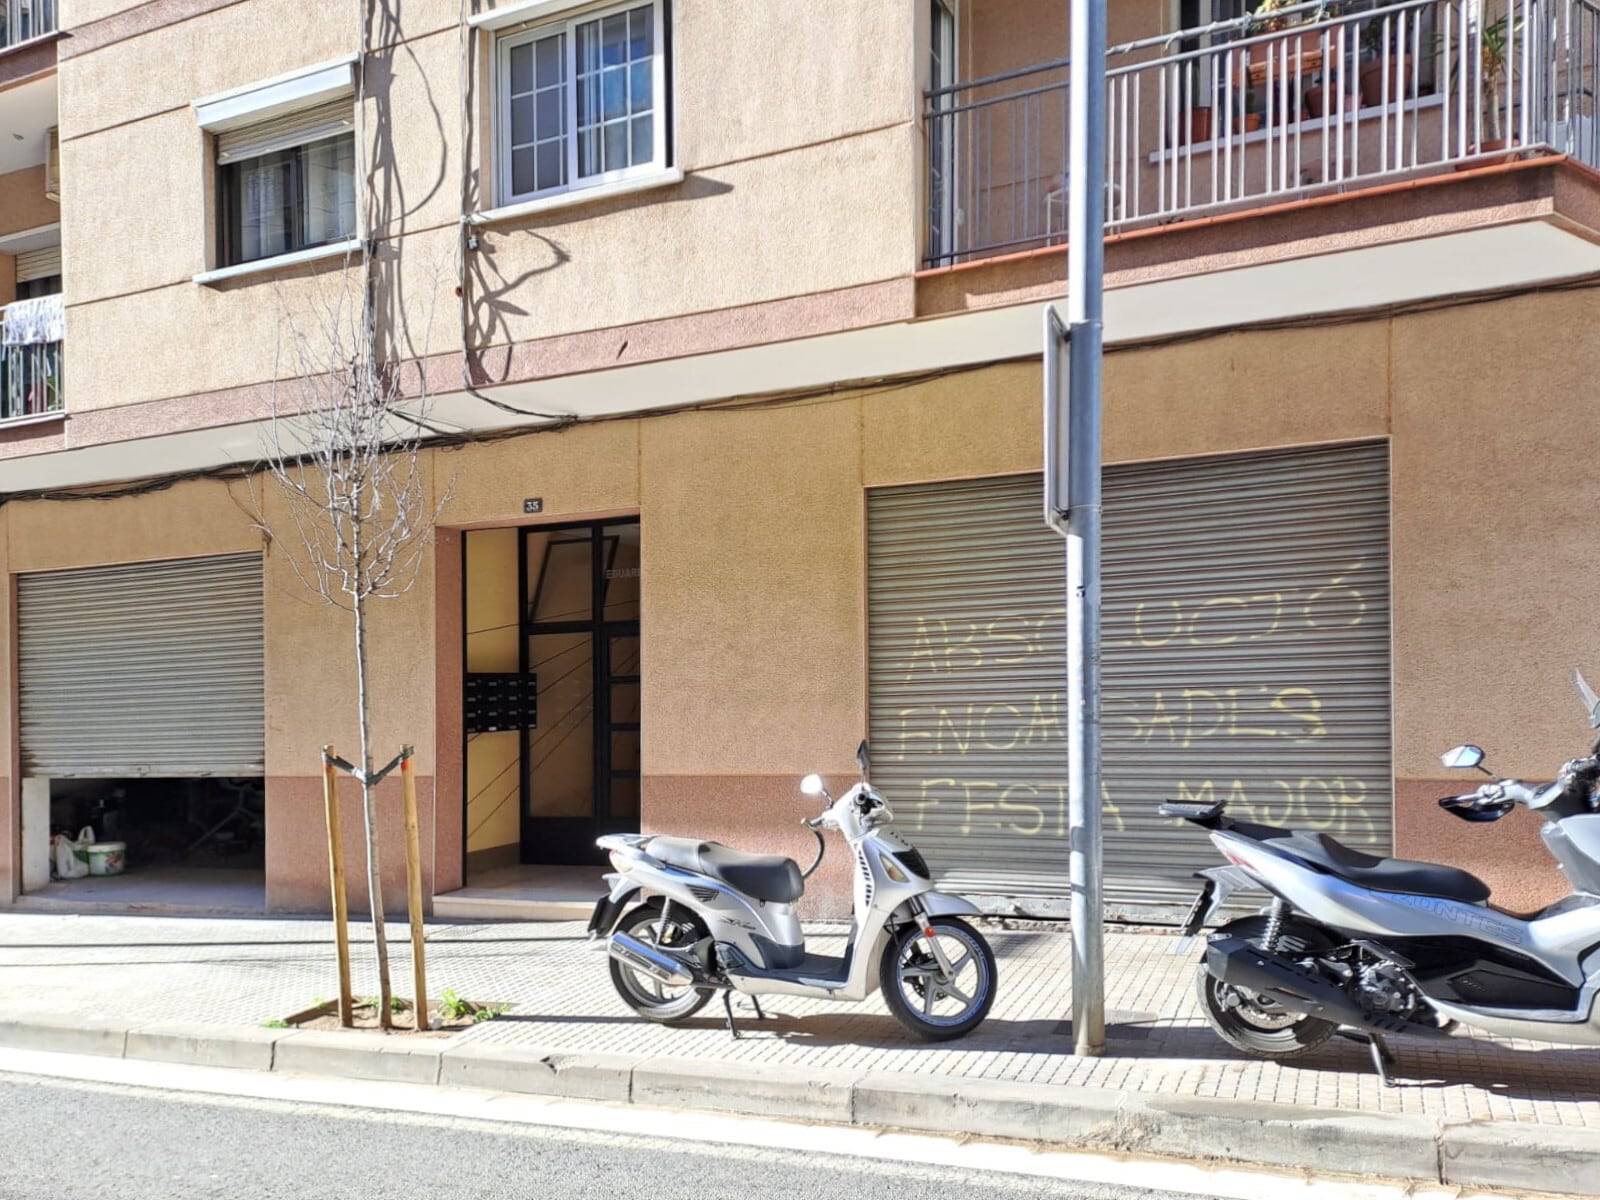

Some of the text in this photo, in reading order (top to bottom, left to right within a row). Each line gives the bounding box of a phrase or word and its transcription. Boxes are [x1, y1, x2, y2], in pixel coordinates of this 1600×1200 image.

[526, 501, 539, 511] 35
[916, 776, 1378, 844] FESTA MAJOR
